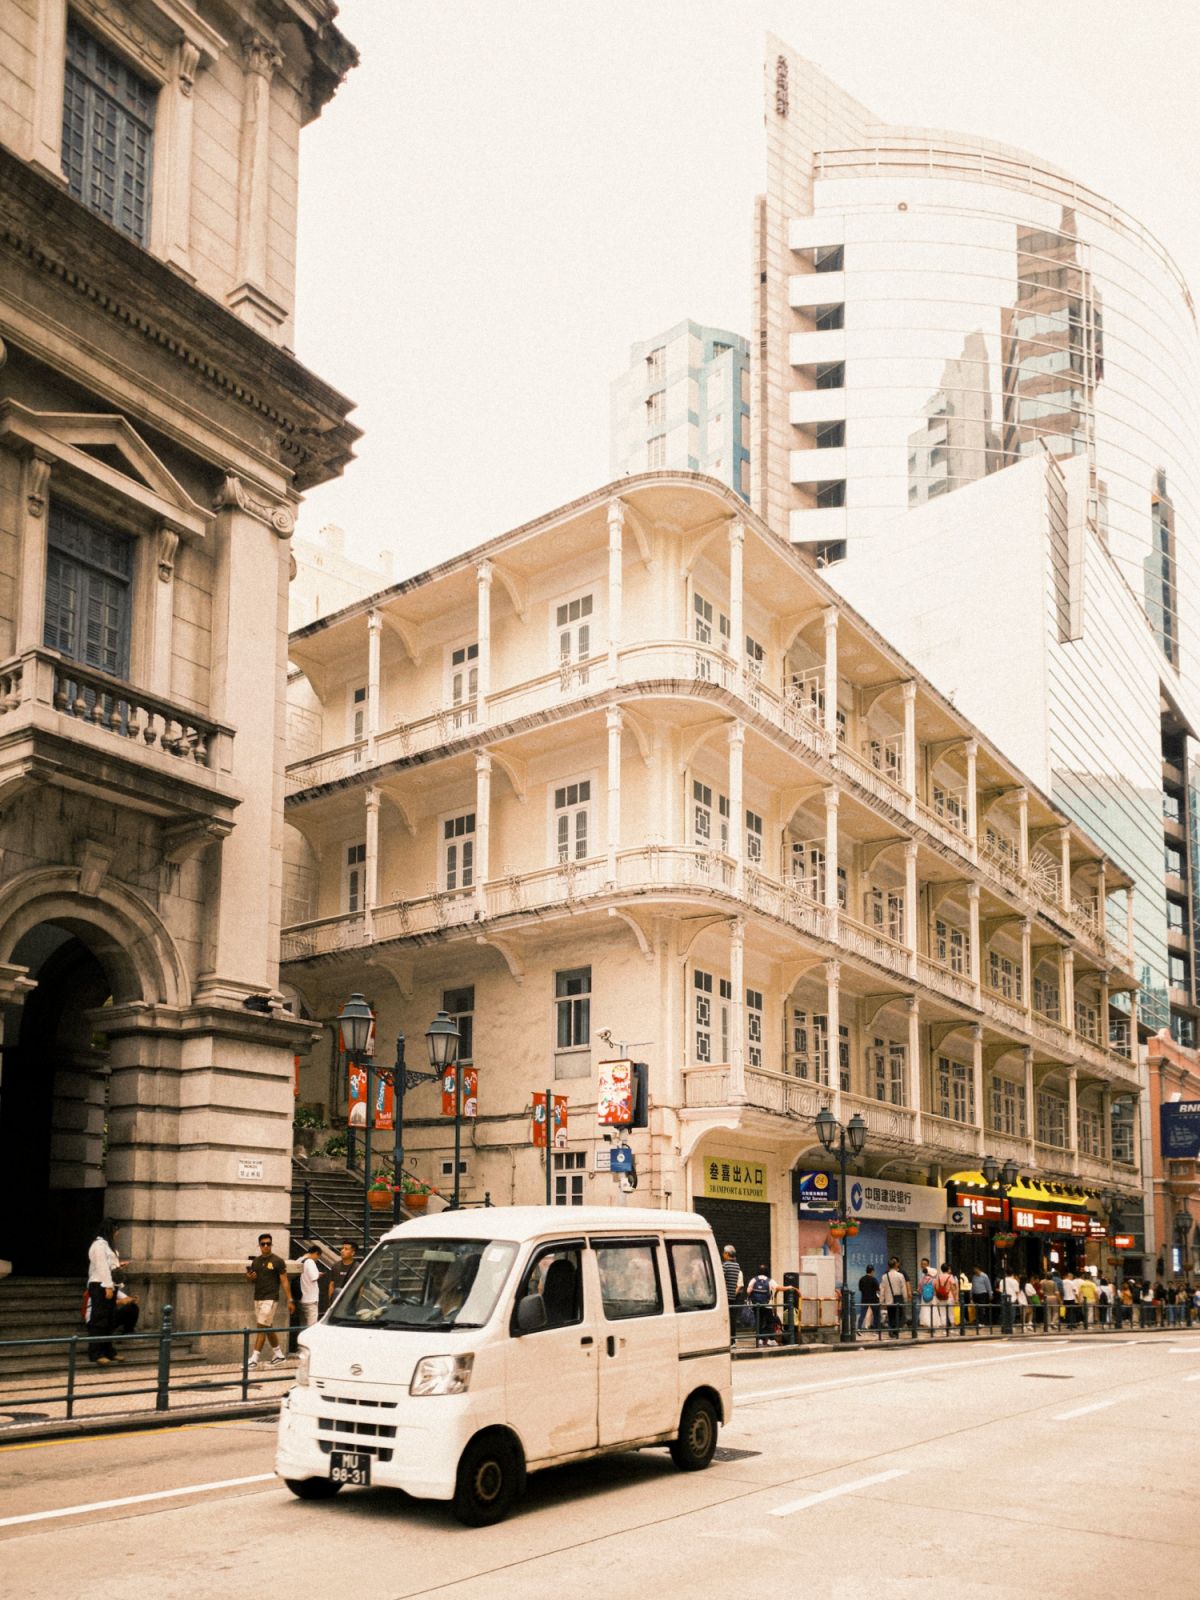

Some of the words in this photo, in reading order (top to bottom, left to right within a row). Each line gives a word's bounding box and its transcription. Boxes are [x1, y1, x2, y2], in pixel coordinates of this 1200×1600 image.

[717, 1185, 738, 1195] IMPORT
[743, 1188, 763, 1197] EXPORT
[864, 1186, 912, 1205] 中国建设银行
[341, 1454, 359, 1469] MU
[332, 1467, 366, 1485] 98-31
